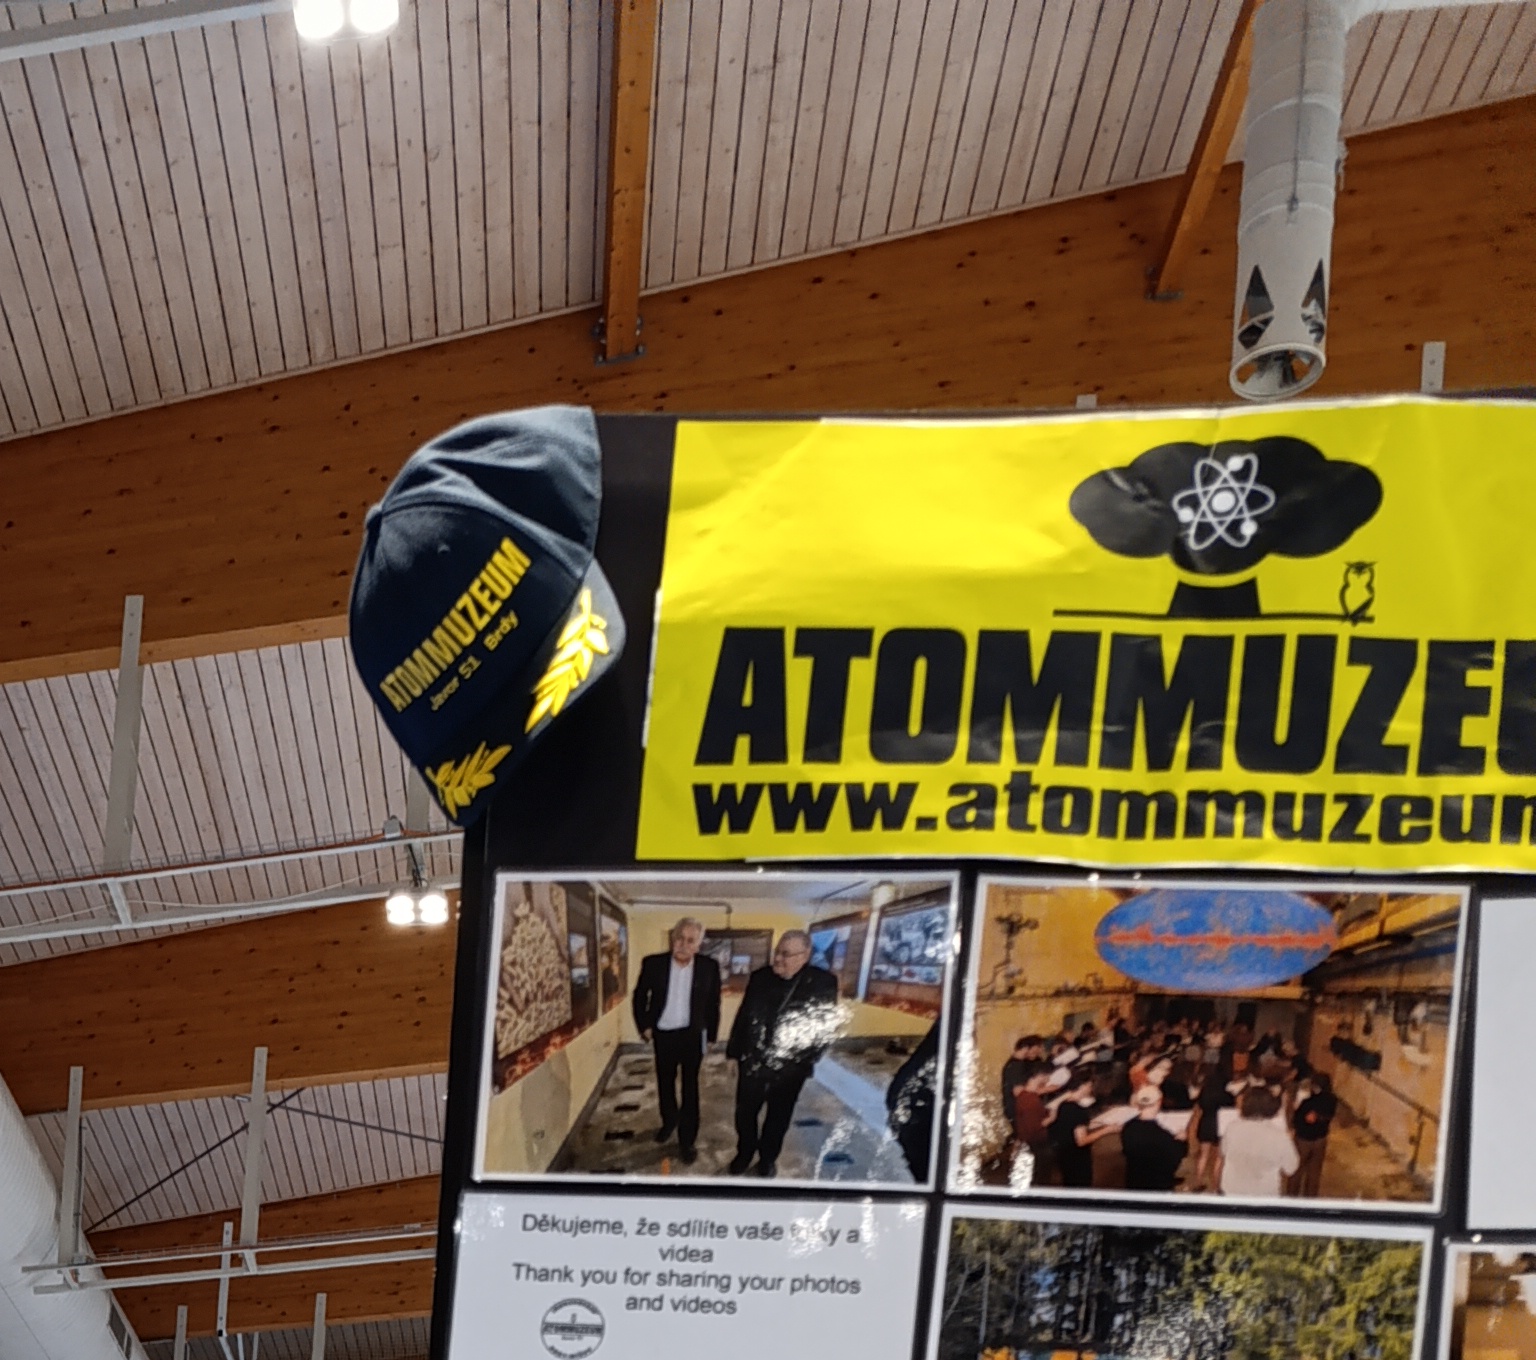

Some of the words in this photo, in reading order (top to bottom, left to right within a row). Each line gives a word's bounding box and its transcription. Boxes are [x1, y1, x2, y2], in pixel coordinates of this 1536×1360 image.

[378, 536, 532, 713] ATOMMUZEUM
[429, 676, 460, 711] Javor
[458, 655, 482, 680] 51
[483, 609, 519, 651] Brdy
[521, 1213, 628, 1239] Děkujeme,
[635, 1217, 661, 1237] že
[735, 1221, 784, 1241] vaše
[846, 1228, 861, 1244] a
[658, 1244, 714, 1264] videa
[512, 1262, 575, 1284] Thank
[581, 1267, 618, 1288] you
[624, 1266, 652, 1286] for
[656, 1269, 732, 1294] sharing
[737, 1275, 785, 1295] your
[789, 1273, 863, 1297] photos
[625, 1294, 665, 1312] and
[670, 1296, 739, 1316] videos
